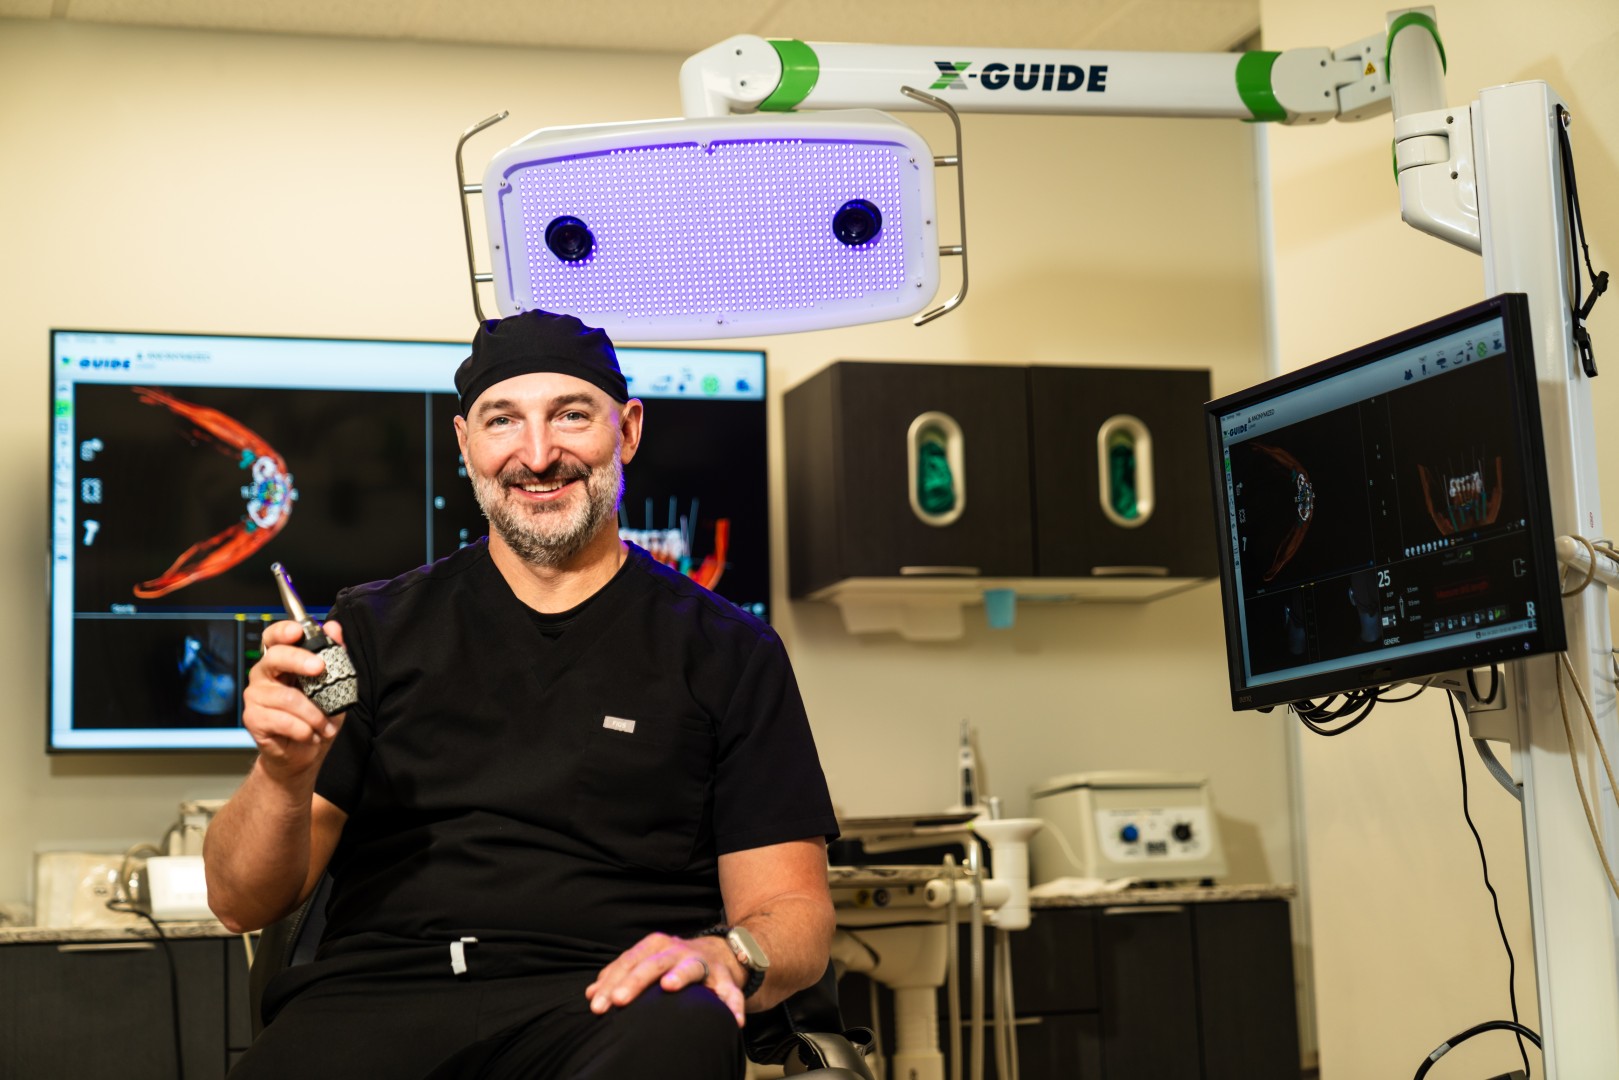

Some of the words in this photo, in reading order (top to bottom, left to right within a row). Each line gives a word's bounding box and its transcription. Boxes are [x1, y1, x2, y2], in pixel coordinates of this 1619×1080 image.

[928, 61, 1108, 92] X-GUIDE
[1377, 569, 1391, 588] 25
[1526, 601, 1536, 617] R
